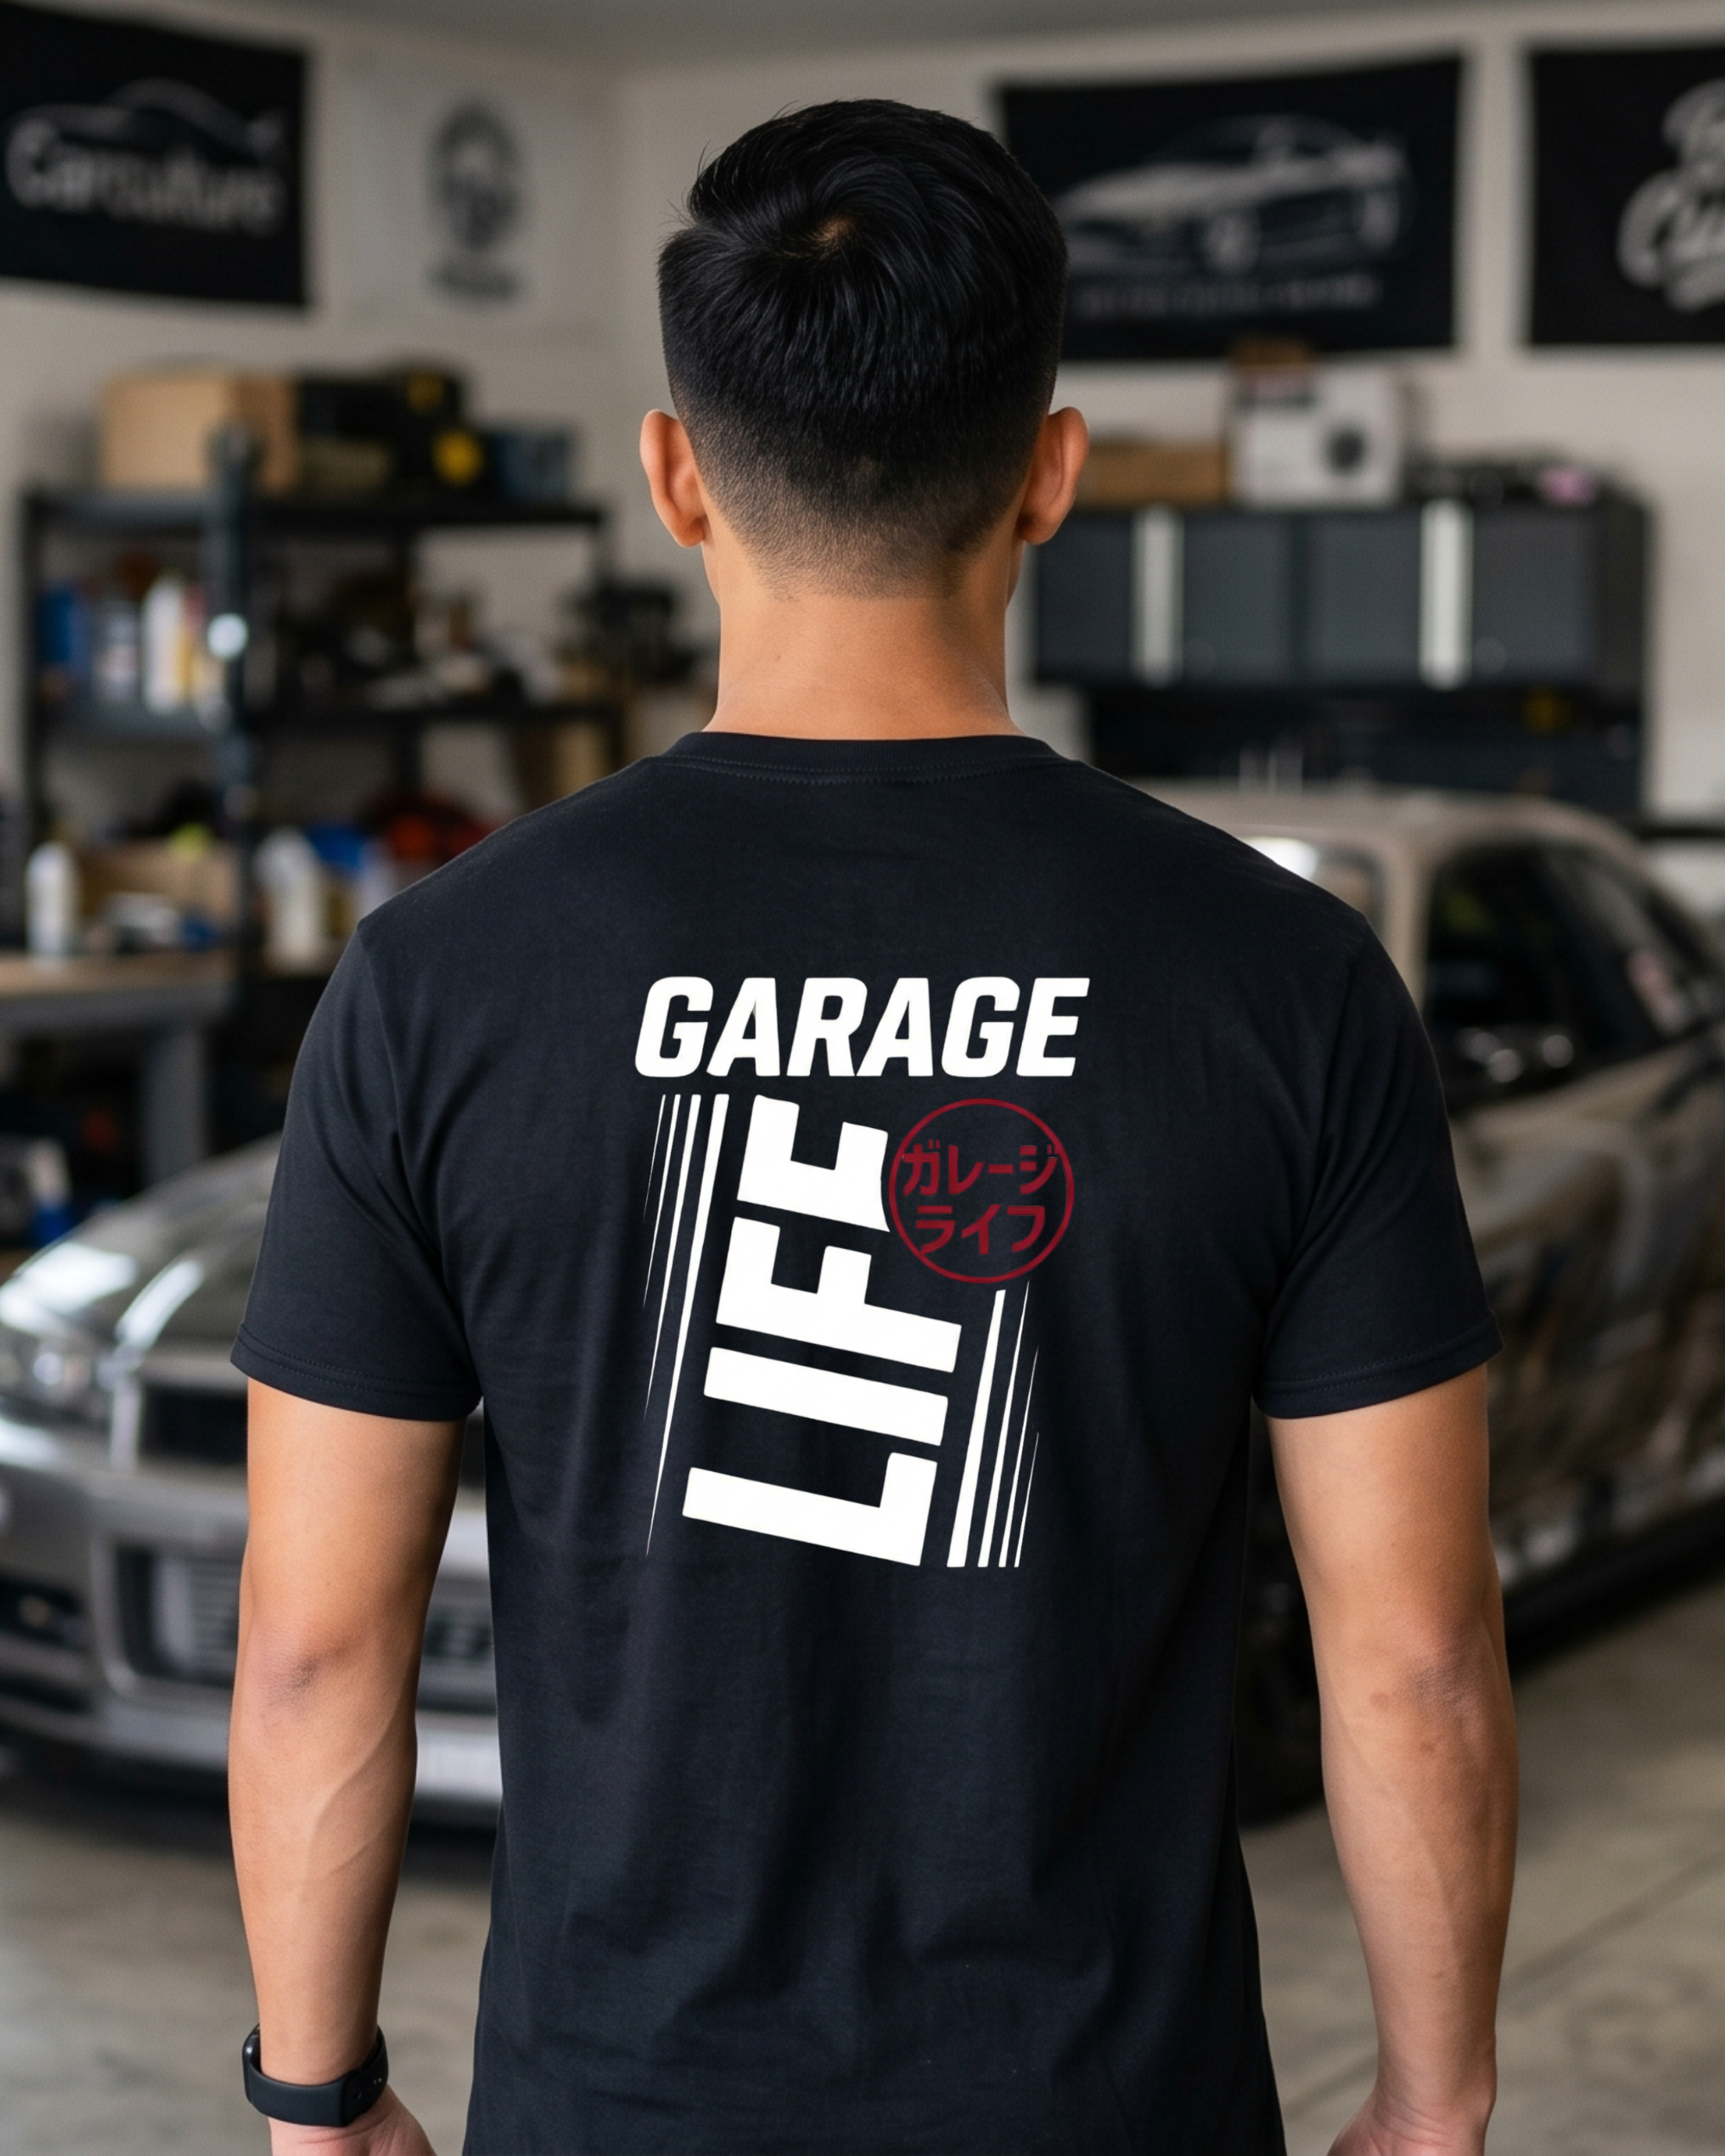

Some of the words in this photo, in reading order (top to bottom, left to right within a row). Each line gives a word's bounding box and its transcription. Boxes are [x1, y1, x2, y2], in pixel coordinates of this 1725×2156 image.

[636, 976, 1089, 1077] GARAGE
[903, 1138, 1059, 1196] ガレージ
[915, 1204, 1045, 1255] ライフ
[682, 1094, 962, 1566] LIFE
